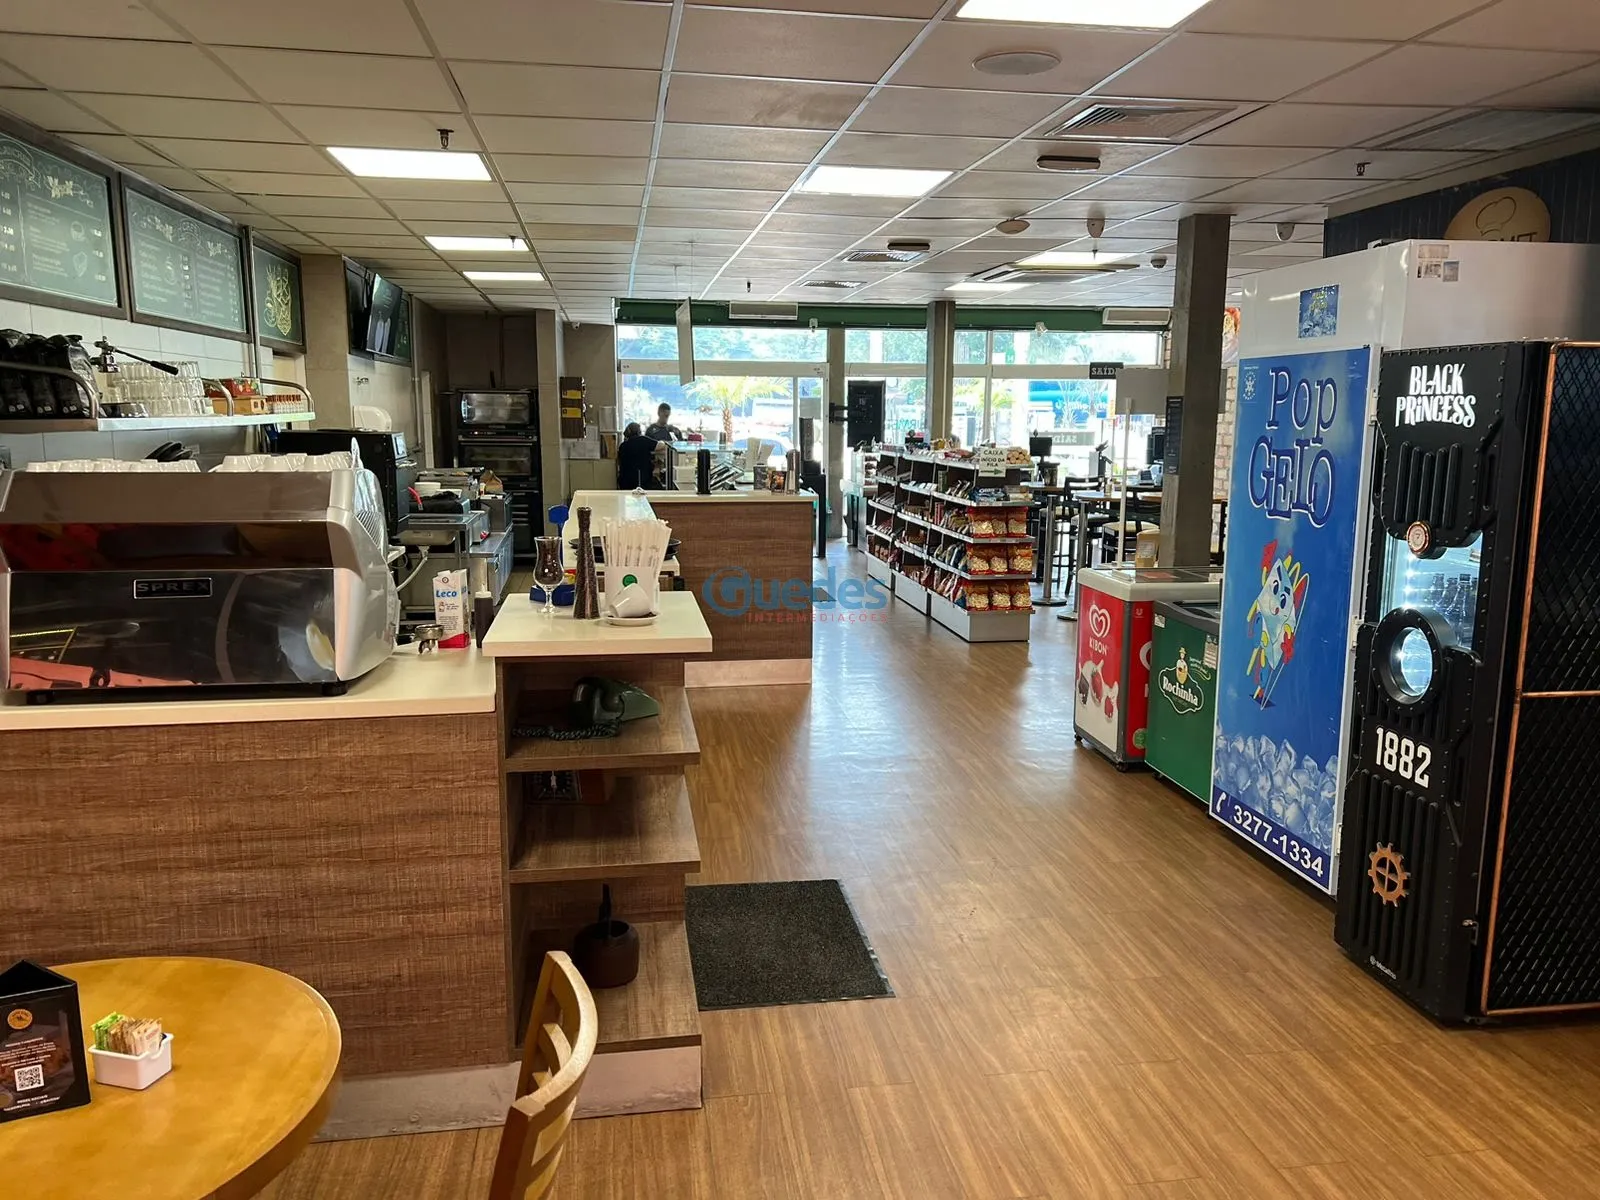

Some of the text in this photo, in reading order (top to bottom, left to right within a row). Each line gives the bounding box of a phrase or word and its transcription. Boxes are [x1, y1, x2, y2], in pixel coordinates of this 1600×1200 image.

[1409, 363, 1465, 396] BLACK
[1265, 367, 1338, 448] Pop
[1248, 435, 1337, 529] GELO
[136, 580, 210, 592] SPREX
[435, 588, 458, 598] Leco
[1089, 636, 1107, 656] KIBON
[1162, 676, 1199, 706] Rochinha
[1375, 726, 1432, 788] 1882
[1232, 804, 1324, 878] 3277-1334
